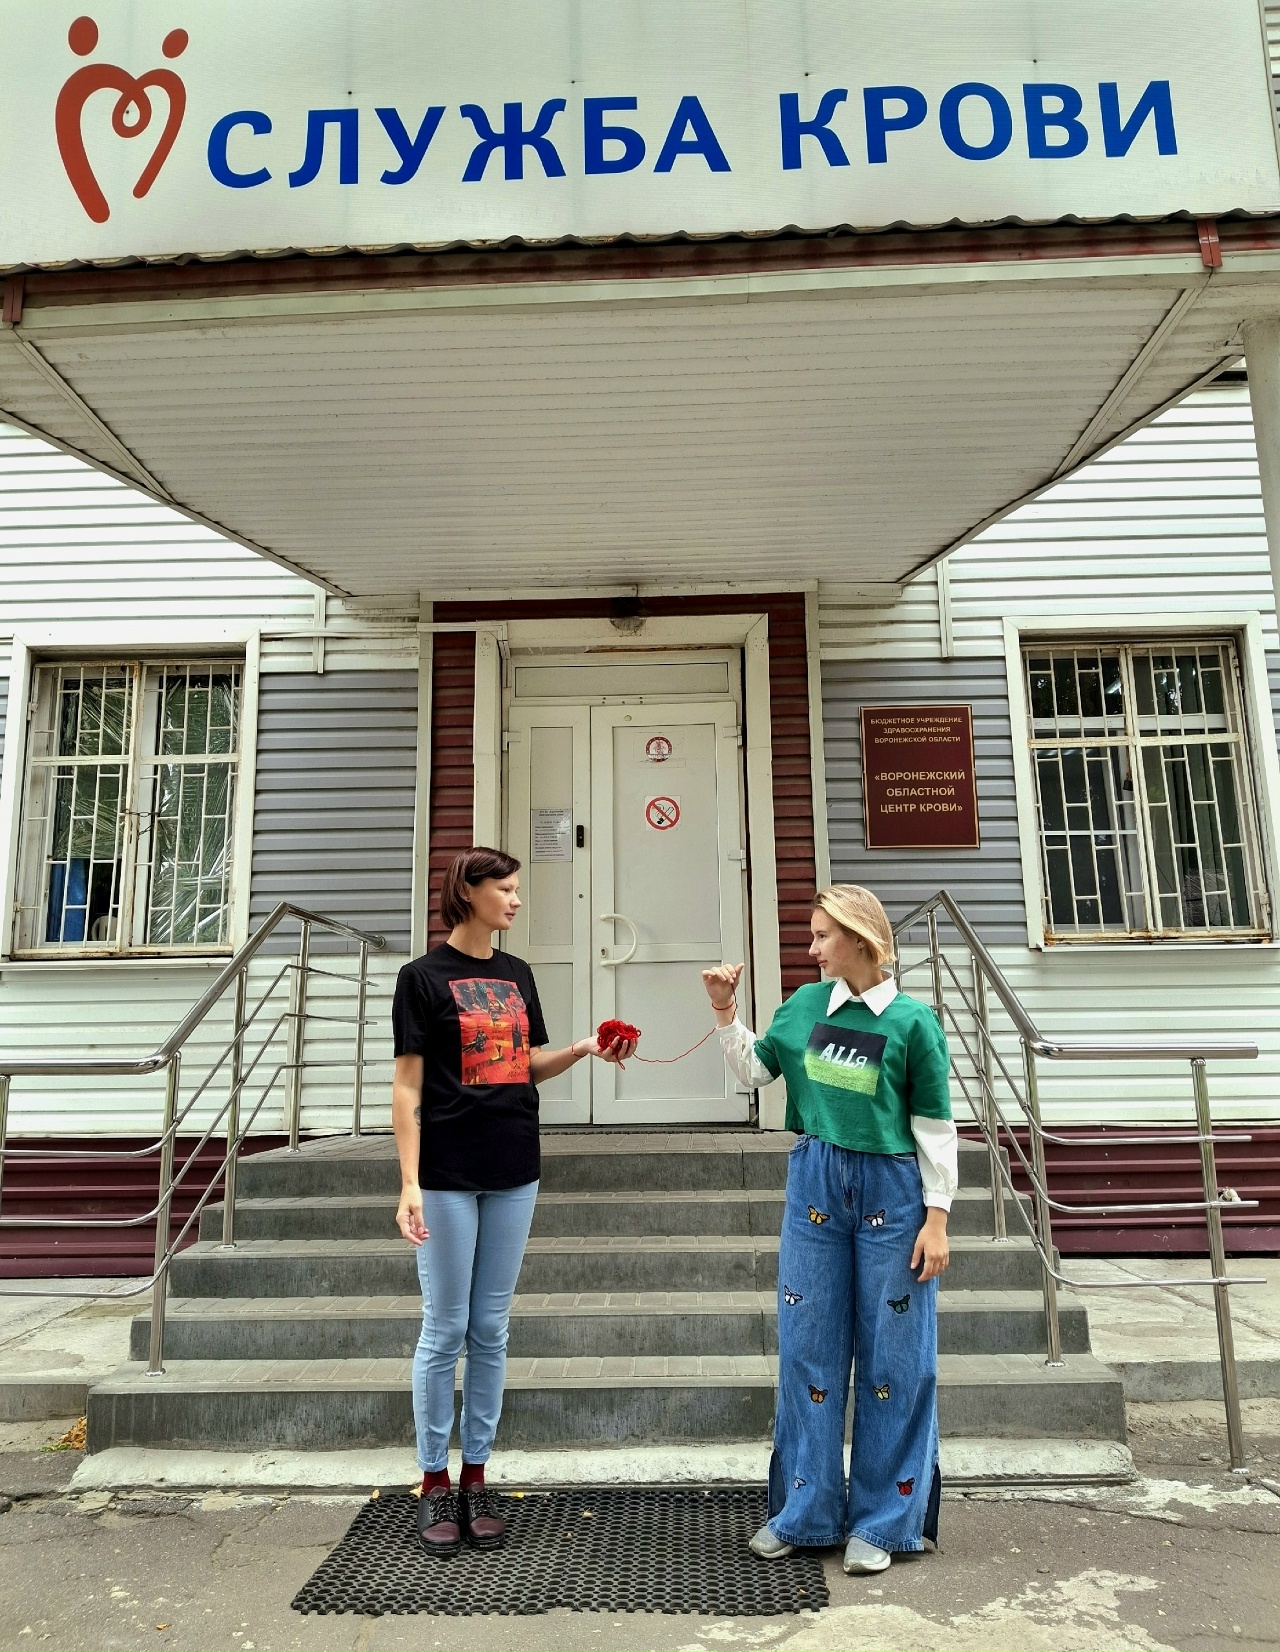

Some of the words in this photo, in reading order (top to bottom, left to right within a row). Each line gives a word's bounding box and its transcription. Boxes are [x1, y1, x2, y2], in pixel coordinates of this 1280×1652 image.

[207, 95, 732, 189] СЛУЖБА
[780, 80, 1180, 171] КРОВИ
[870, 717, 915, 725] БЮДЖЕТНОЕ
[916, 716, 963, 724] УЧРЕЖДЕНИЕ
[874, 736, 927, 744] ВОРОНЕЖСКОЙ
[874, 769, 966, 781] «ВОРОНЕЖСКИЙ
[886, 785, 955, 797] ОБЛАСТНОЙ
[880, 804, 917, 814] ЦЕНТР
[919, 803, 963, 813] КРОВИ»
